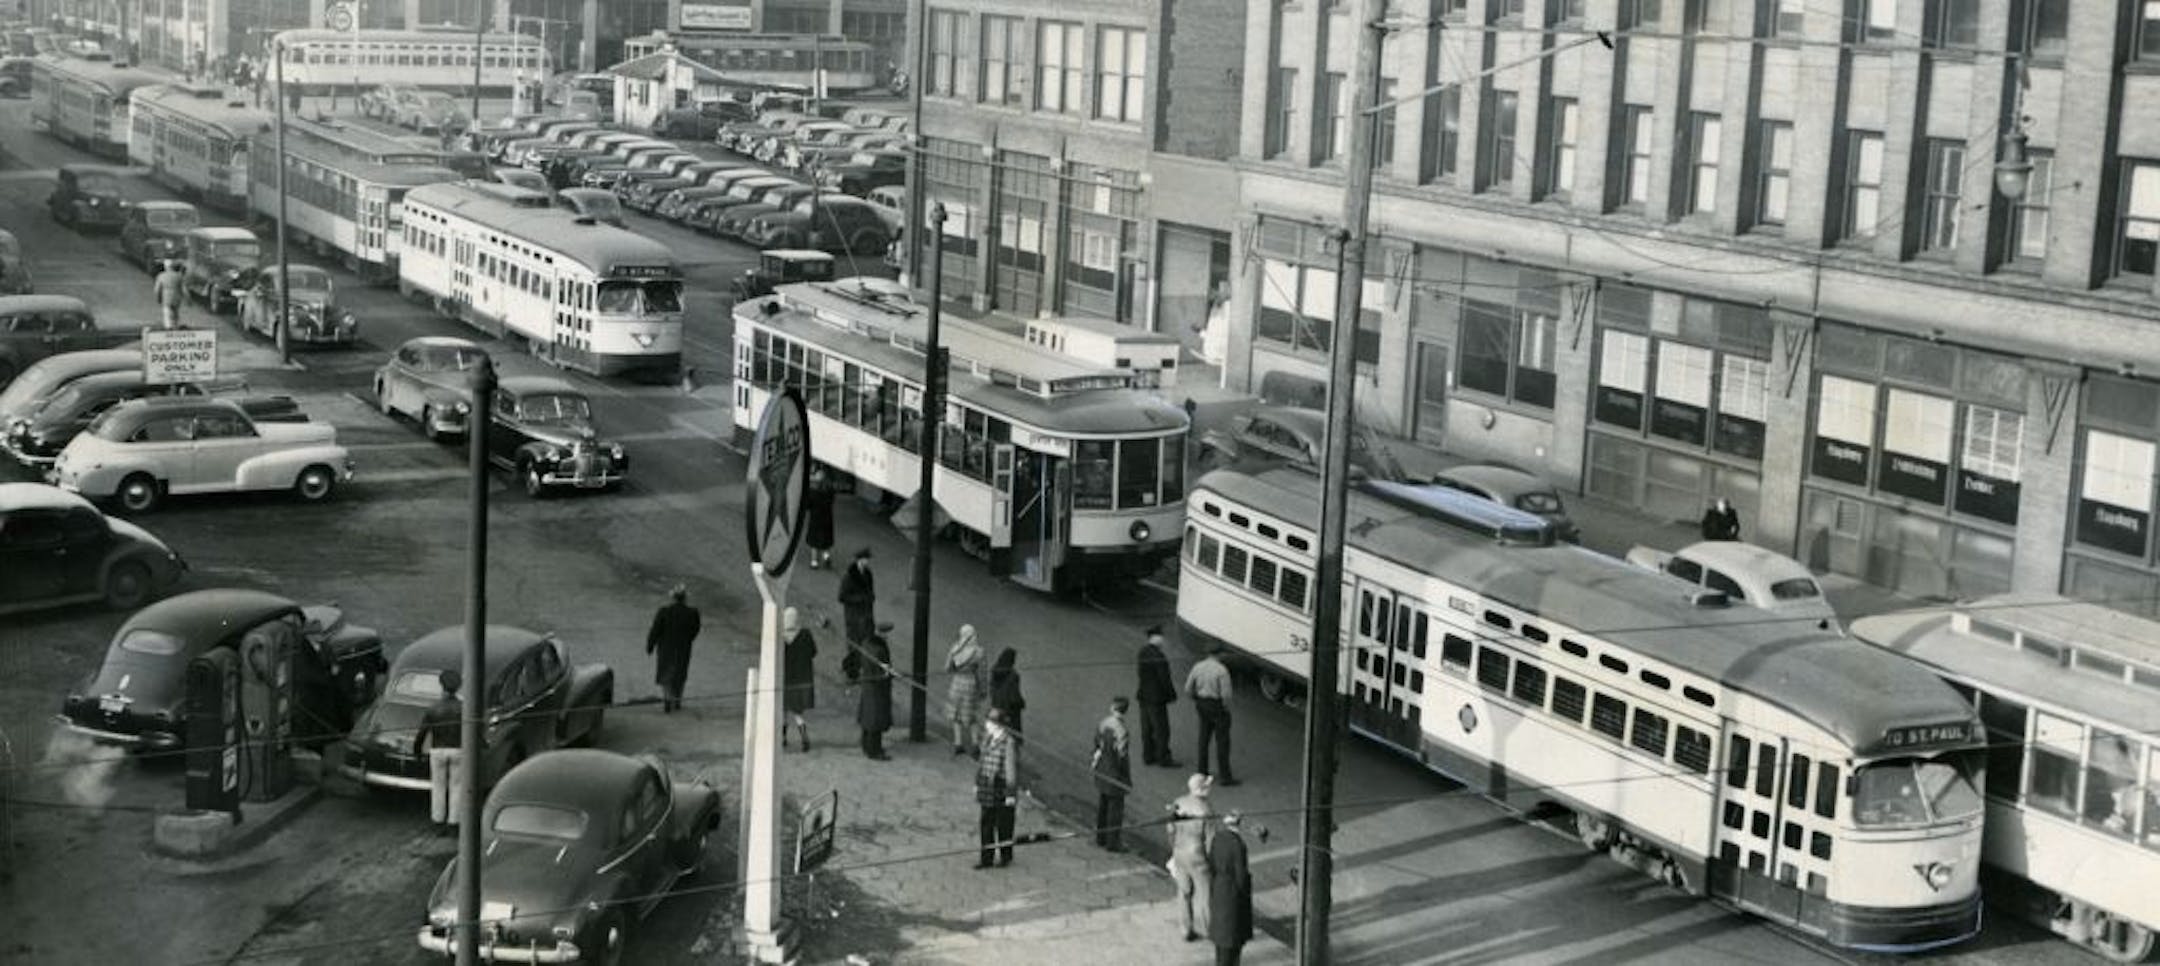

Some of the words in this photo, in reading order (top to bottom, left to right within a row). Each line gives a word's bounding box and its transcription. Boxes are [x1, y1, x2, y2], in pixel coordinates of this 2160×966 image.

[151, 352, 210, 363] PARKING
[1290, 634, 1310, 653] 33
[1931, 726, 1963, 741] PAUL
